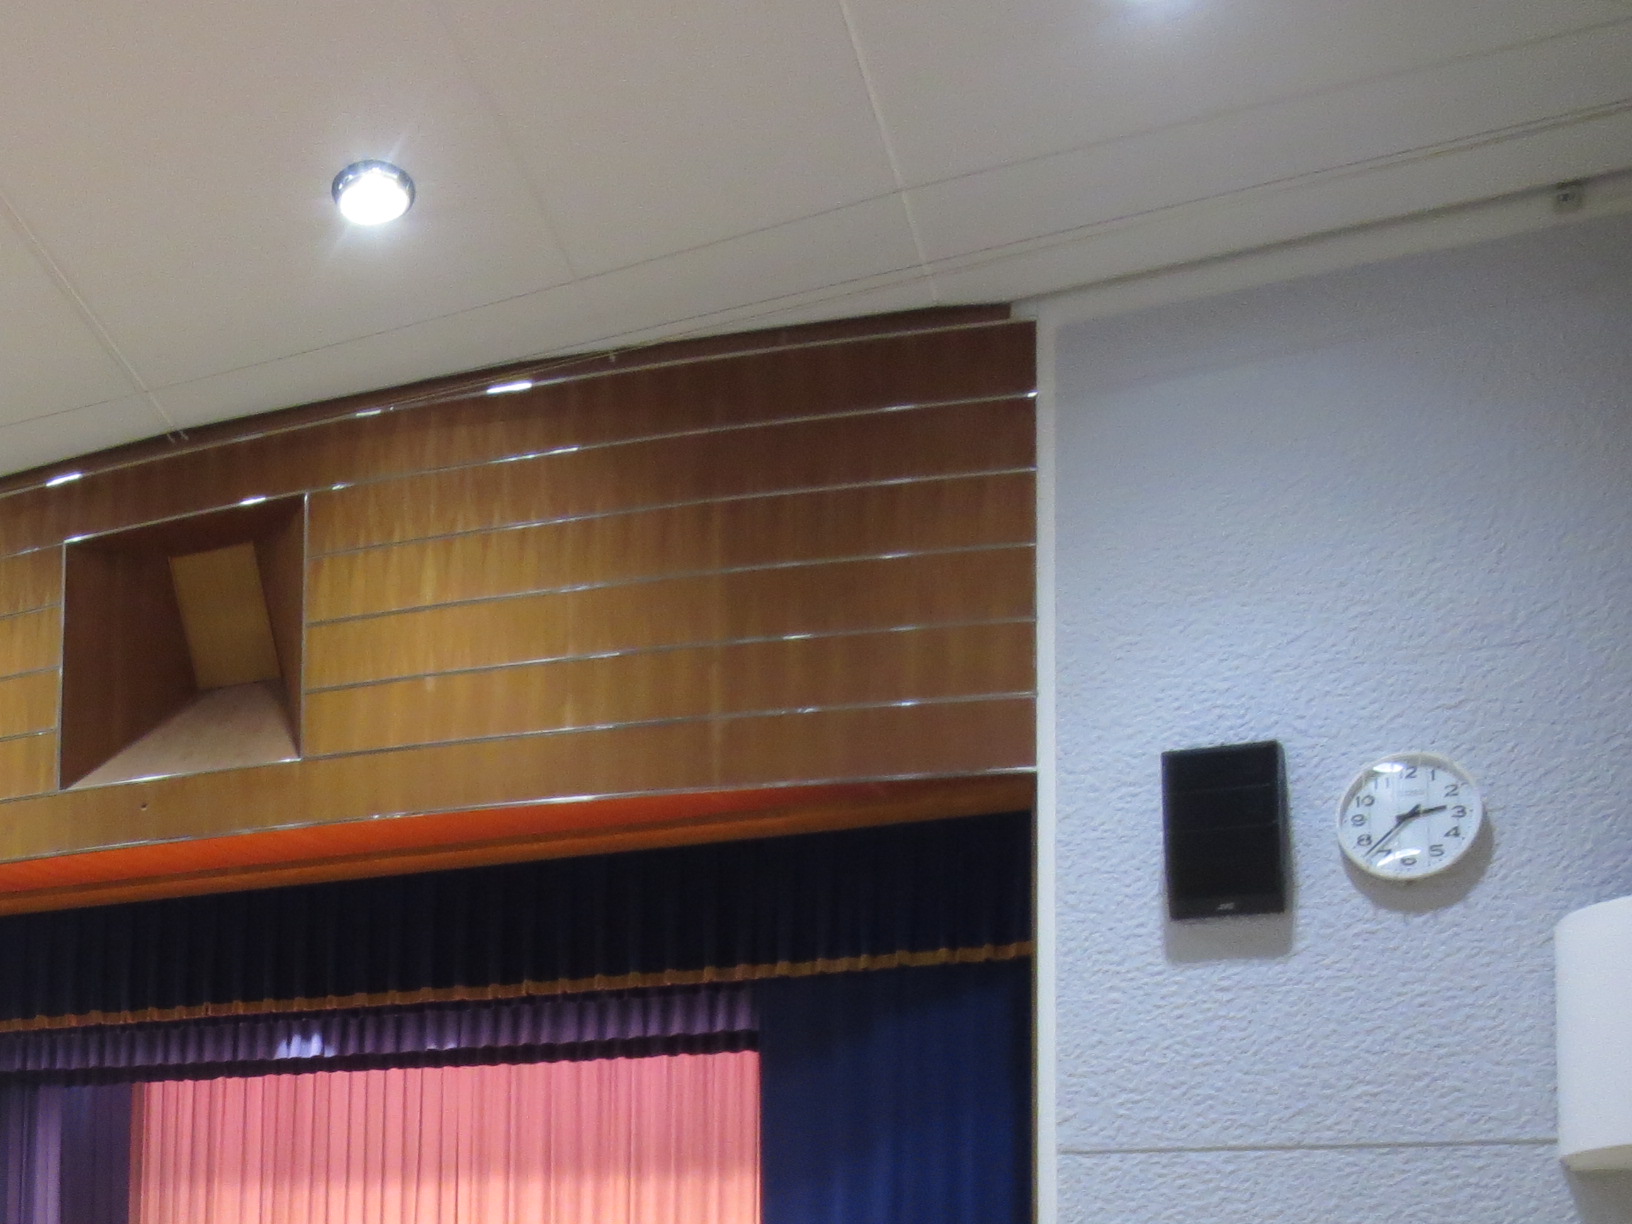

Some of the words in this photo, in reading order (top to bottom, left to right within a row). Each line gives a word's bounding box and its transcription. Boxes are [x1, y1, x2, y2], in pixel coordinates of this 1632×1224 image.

[1431, 769, 1435, 781] 1
[1444, 784, 1459, 798] 2
[1356, 795, 1375, 808] 10
[1451, 805, 1466, 818] 3
[1351, 814, 1365, 827] 9
[1444, 826, 1461, 838] 4
[1357, 834, 1372, 847] 8
[1429, 844, 1445, 857] 5
